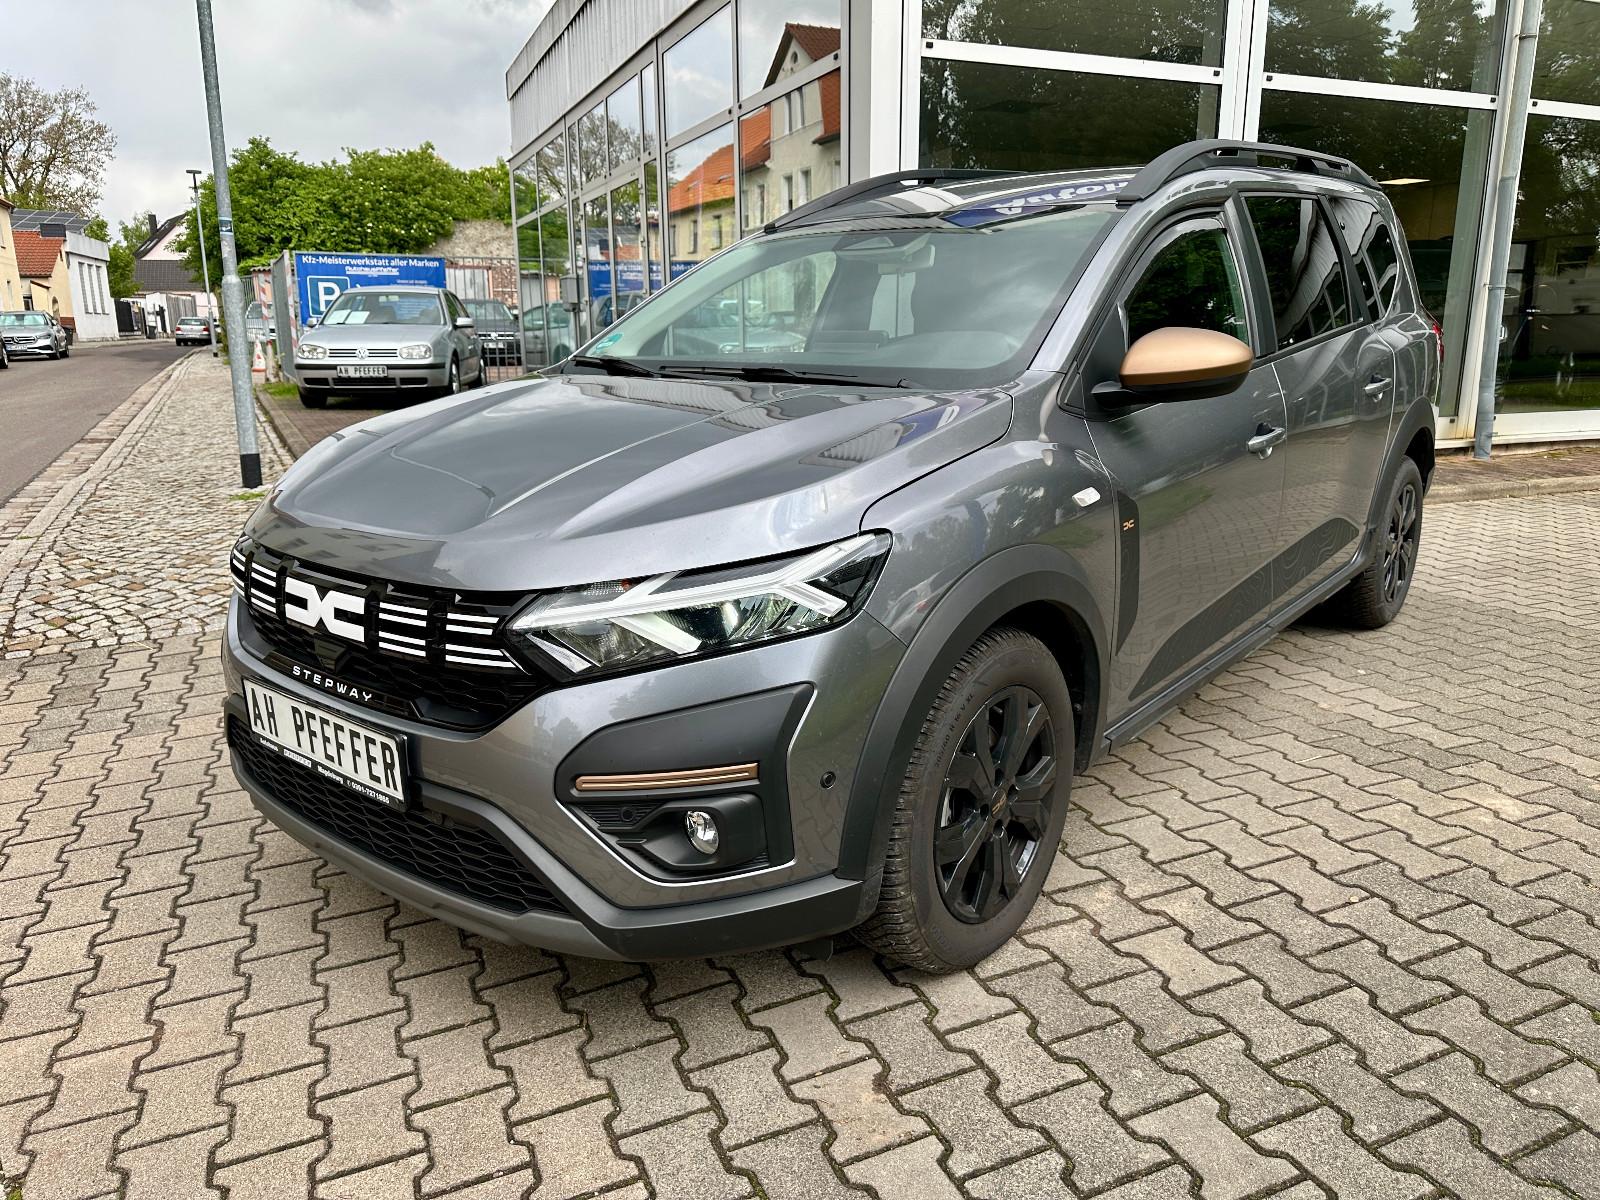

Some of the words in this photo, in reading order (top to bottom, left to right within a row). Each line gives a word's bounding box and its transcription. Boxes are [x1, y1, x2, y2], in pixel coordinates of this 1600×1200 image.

[302, 255, 389, 266] Kfz-Meisterwerkstatt
[390, 257, 407, 267] aller
[409, 258, 439, 268] Marken
[317, 281, 341, 311] P
[338, 367, 349, 375] AH
[354, 366, 386, 376] PFEFFER
[292, 665, 373, 702] STEPWAY
[251, 687, 279, 738] AH
[291, 705, 399, 792] PFEFFER
